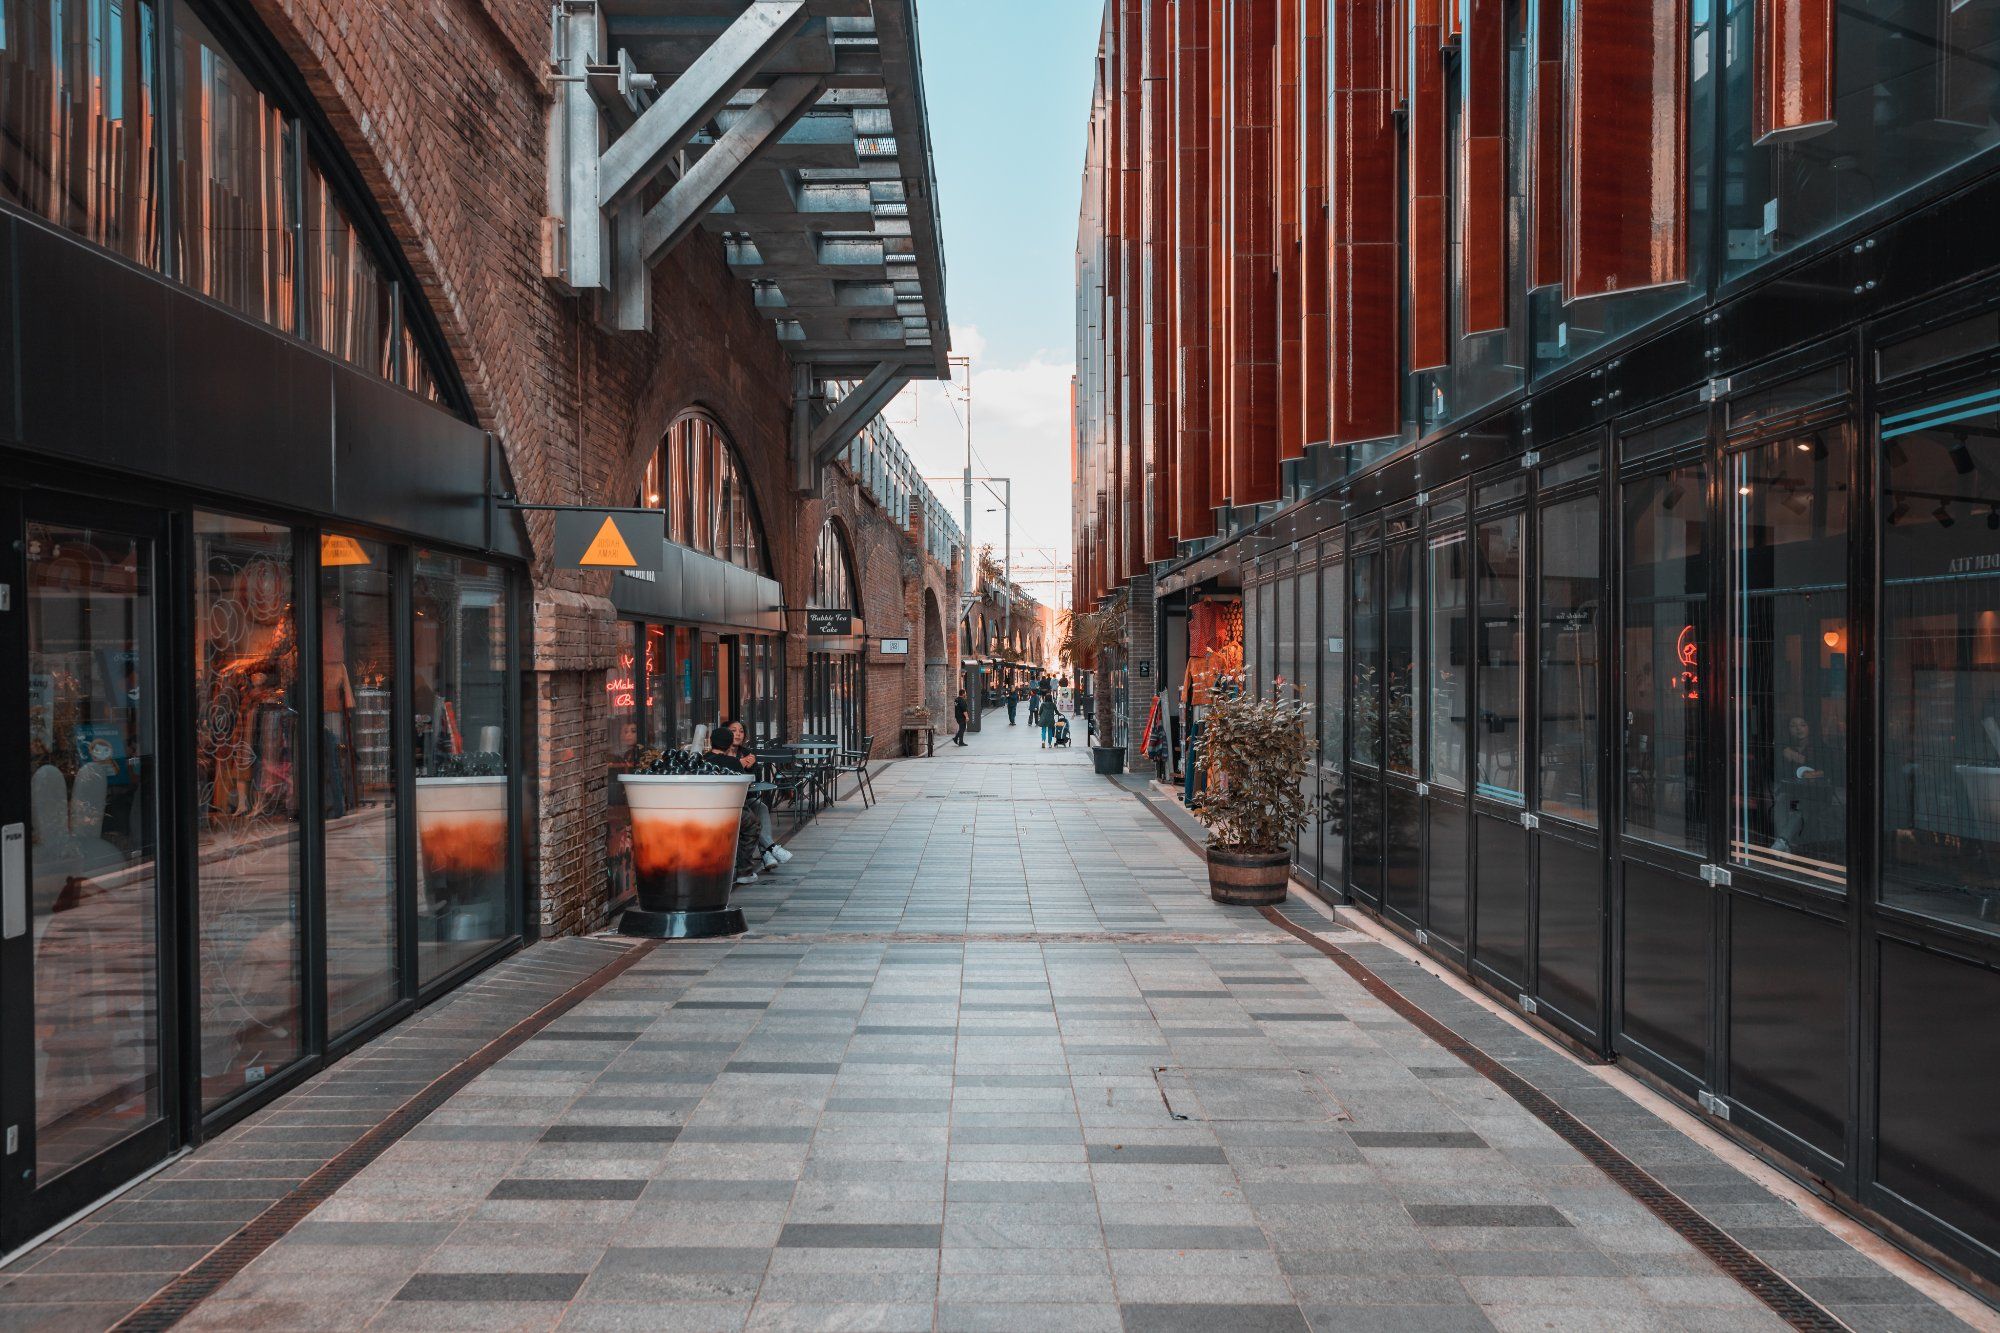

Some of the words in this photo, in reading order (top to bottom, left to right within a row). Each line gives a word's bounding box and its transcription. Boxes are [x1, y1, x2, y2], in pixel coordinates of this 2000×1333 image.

[810, 613, 834, 621] Bubble
[836, 613, 847, 621] Tea
[820, 625, 838, 633] Cake
